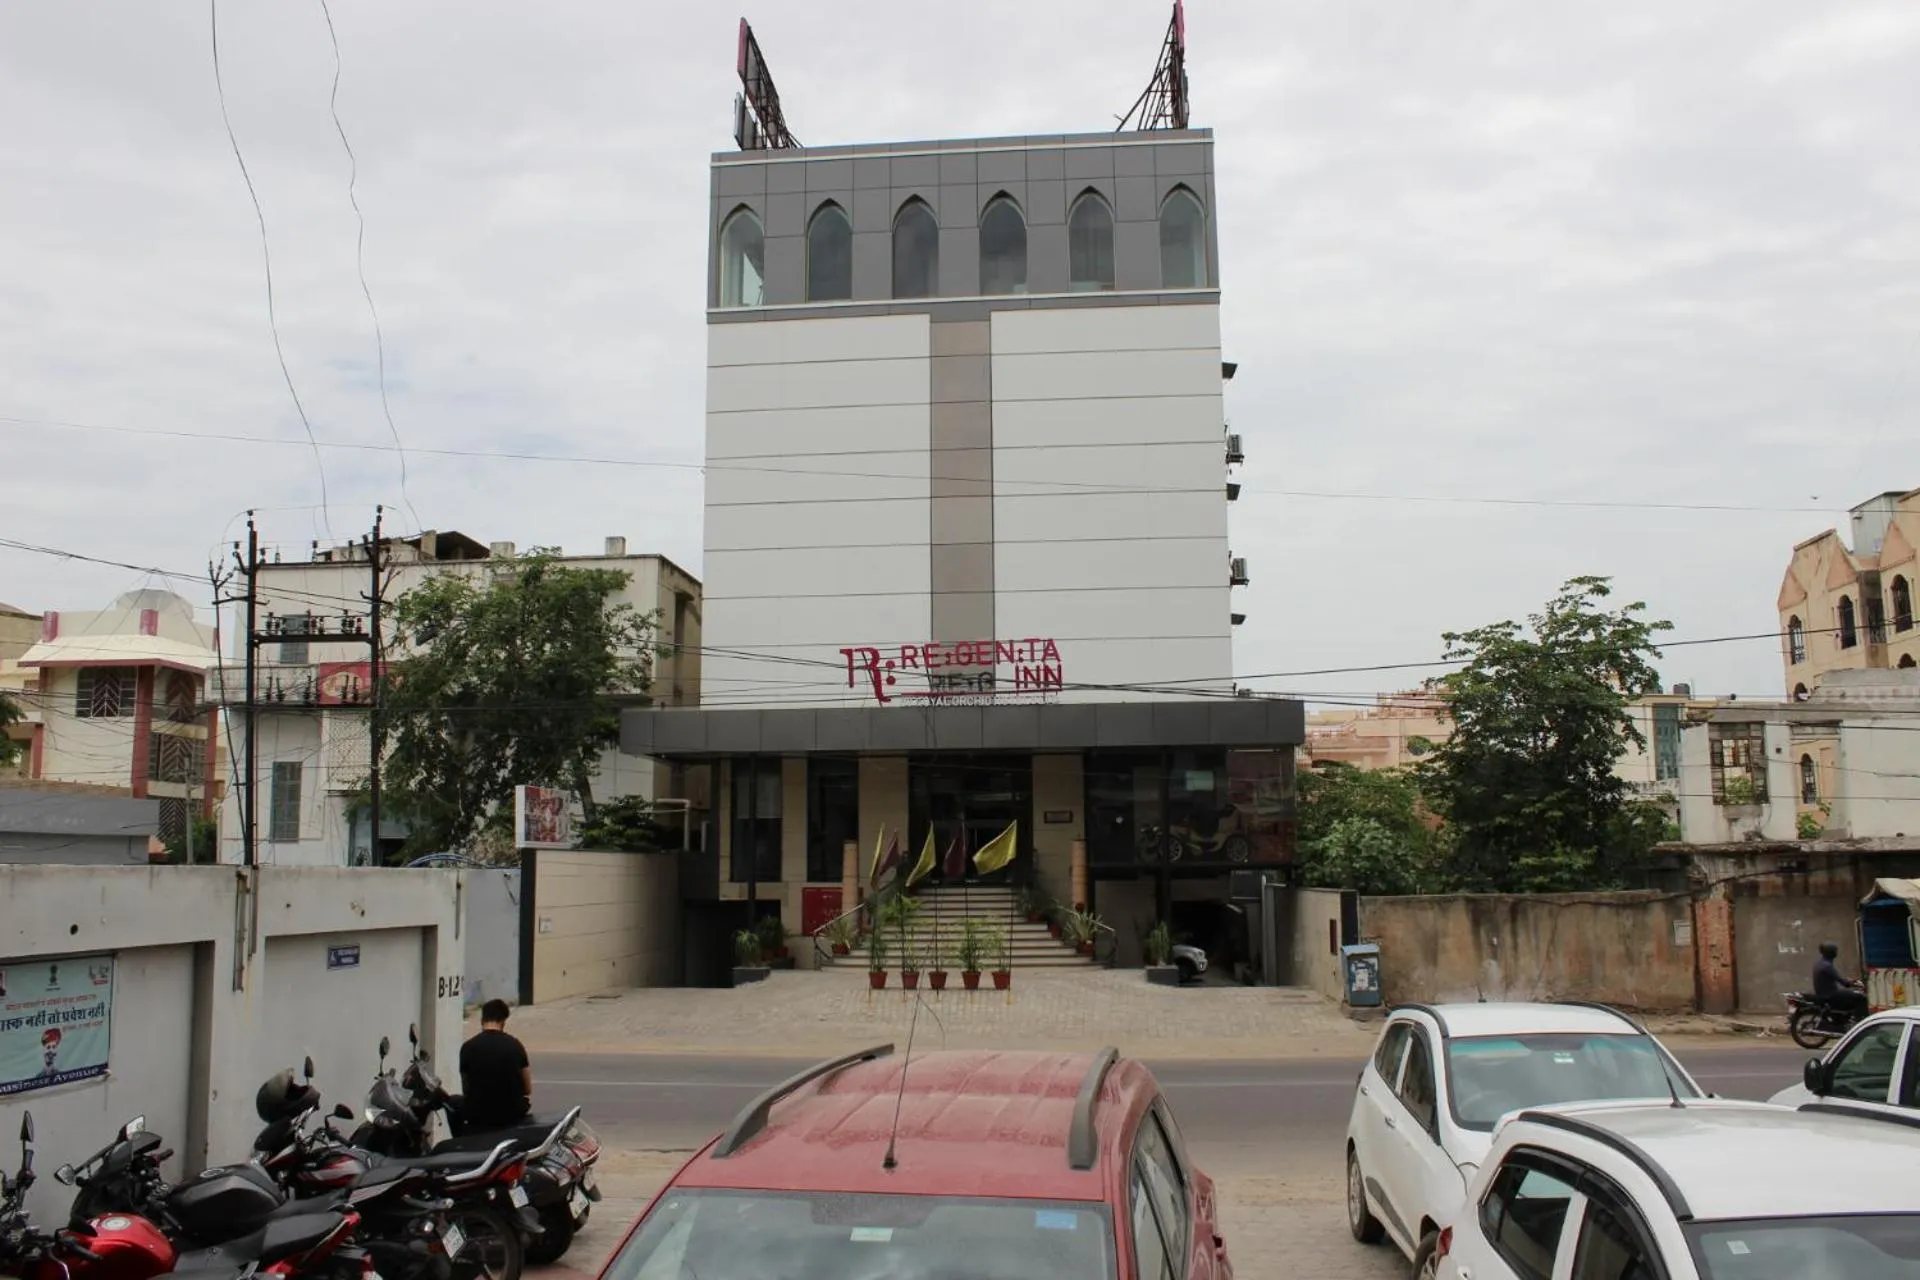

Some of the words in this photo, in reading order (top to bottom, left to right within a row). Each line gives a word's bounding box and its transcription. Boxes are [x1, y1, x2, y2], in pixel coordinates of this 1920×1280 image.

[1015, 664, 1063, 689] INN
[48, 1009, 60, 1025] तो
[62, 1006, 87, 1023] प्रवेश
[0, 1077, 50, 1093] usiness
[54, 1067, 99, 1082] Avenue
